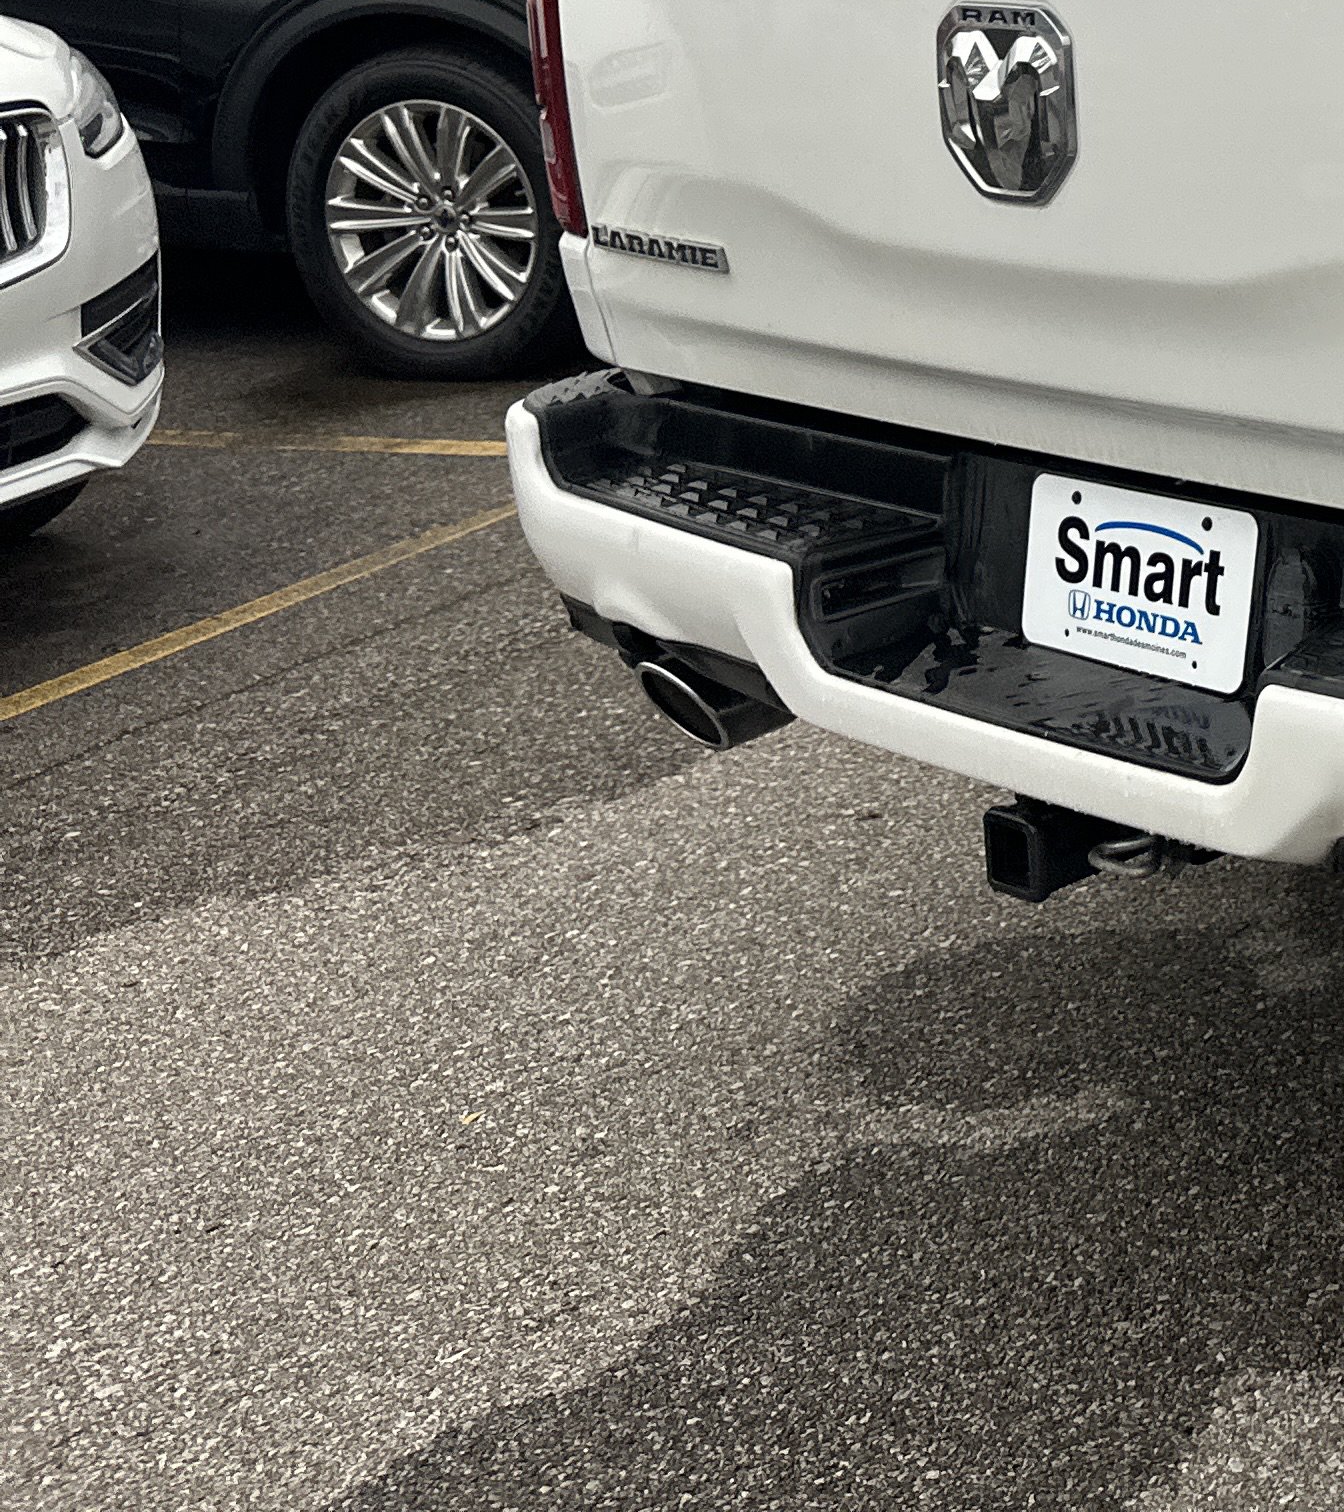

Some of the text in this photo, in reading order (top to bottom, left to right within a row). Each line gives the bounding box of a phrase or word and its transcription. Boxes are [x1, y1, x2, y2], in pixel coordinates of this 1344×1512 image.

[961, 8, 1035, 26] RAM
[591, 224, 719, 269] LARAMIE
[1055, 516, 1225, 616] Smart
[1093, 599, 1203, 645] HONDA
